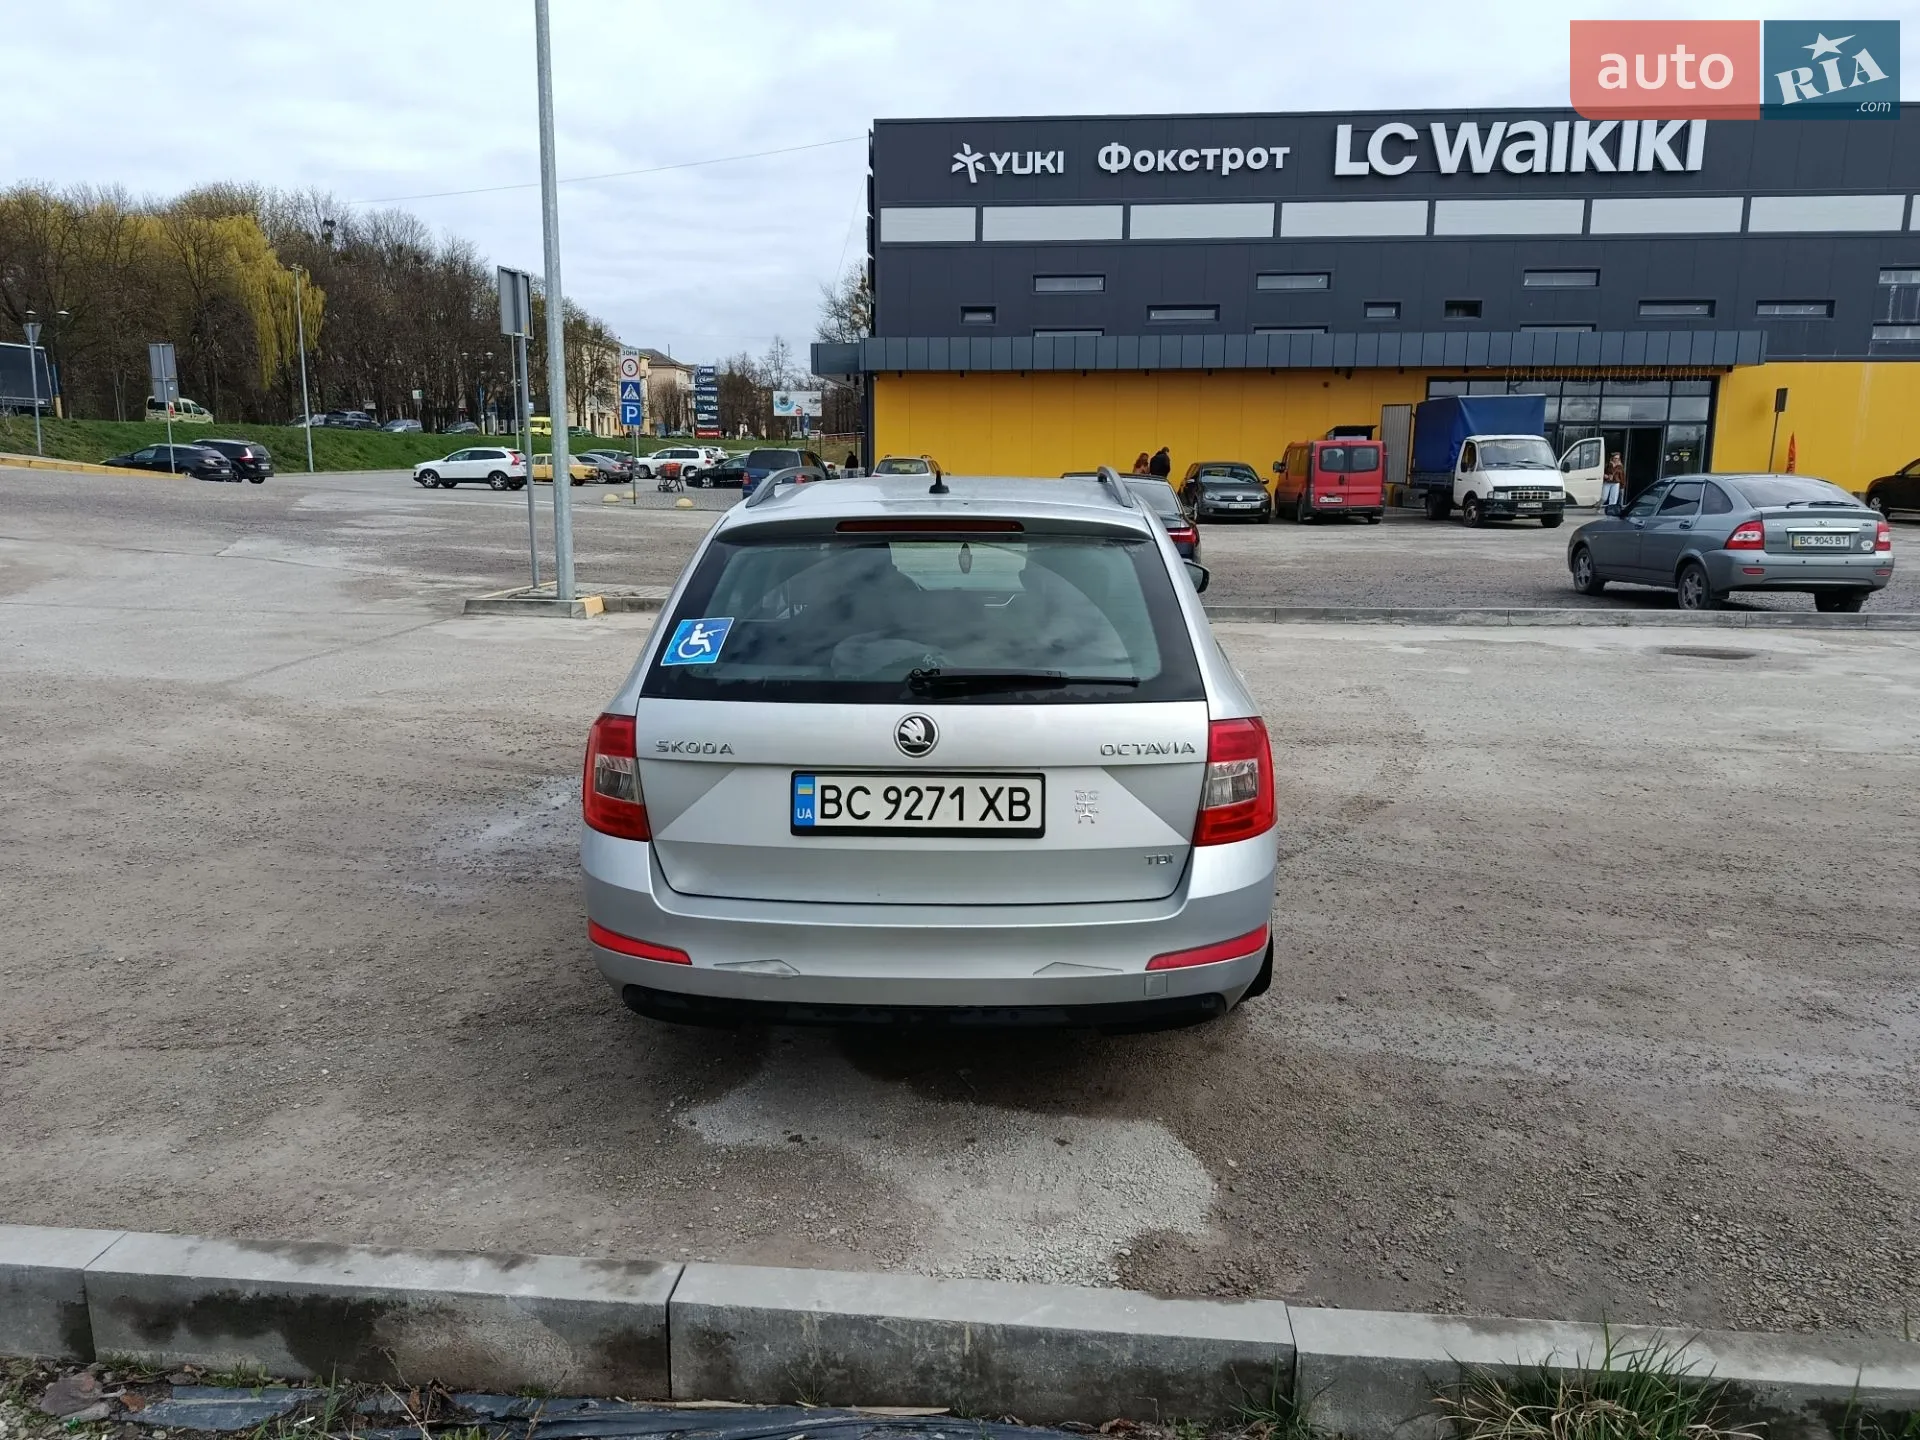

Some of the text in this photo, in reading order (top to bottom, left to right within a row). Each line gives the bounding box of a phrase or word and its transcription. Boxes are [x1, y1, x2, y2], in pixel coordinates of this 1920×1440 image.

[1334, 122, 1420, 176] LC
[989, 150, 1065, 175] YUKI
[1097, 141, 1291, 176] Фокстрот
[627, 364, 633, 372] 5
[626, 405, 639, 423] P
[1799, 536, 1847, 545] BC 9045 BT
[655, 739, 735, 755] SKODA
[1099, 740, 1196, 756] OCTAVIA
[820, 784, 1031, 822] BC 9271 XB
[796, 807, 813, 819] UA
